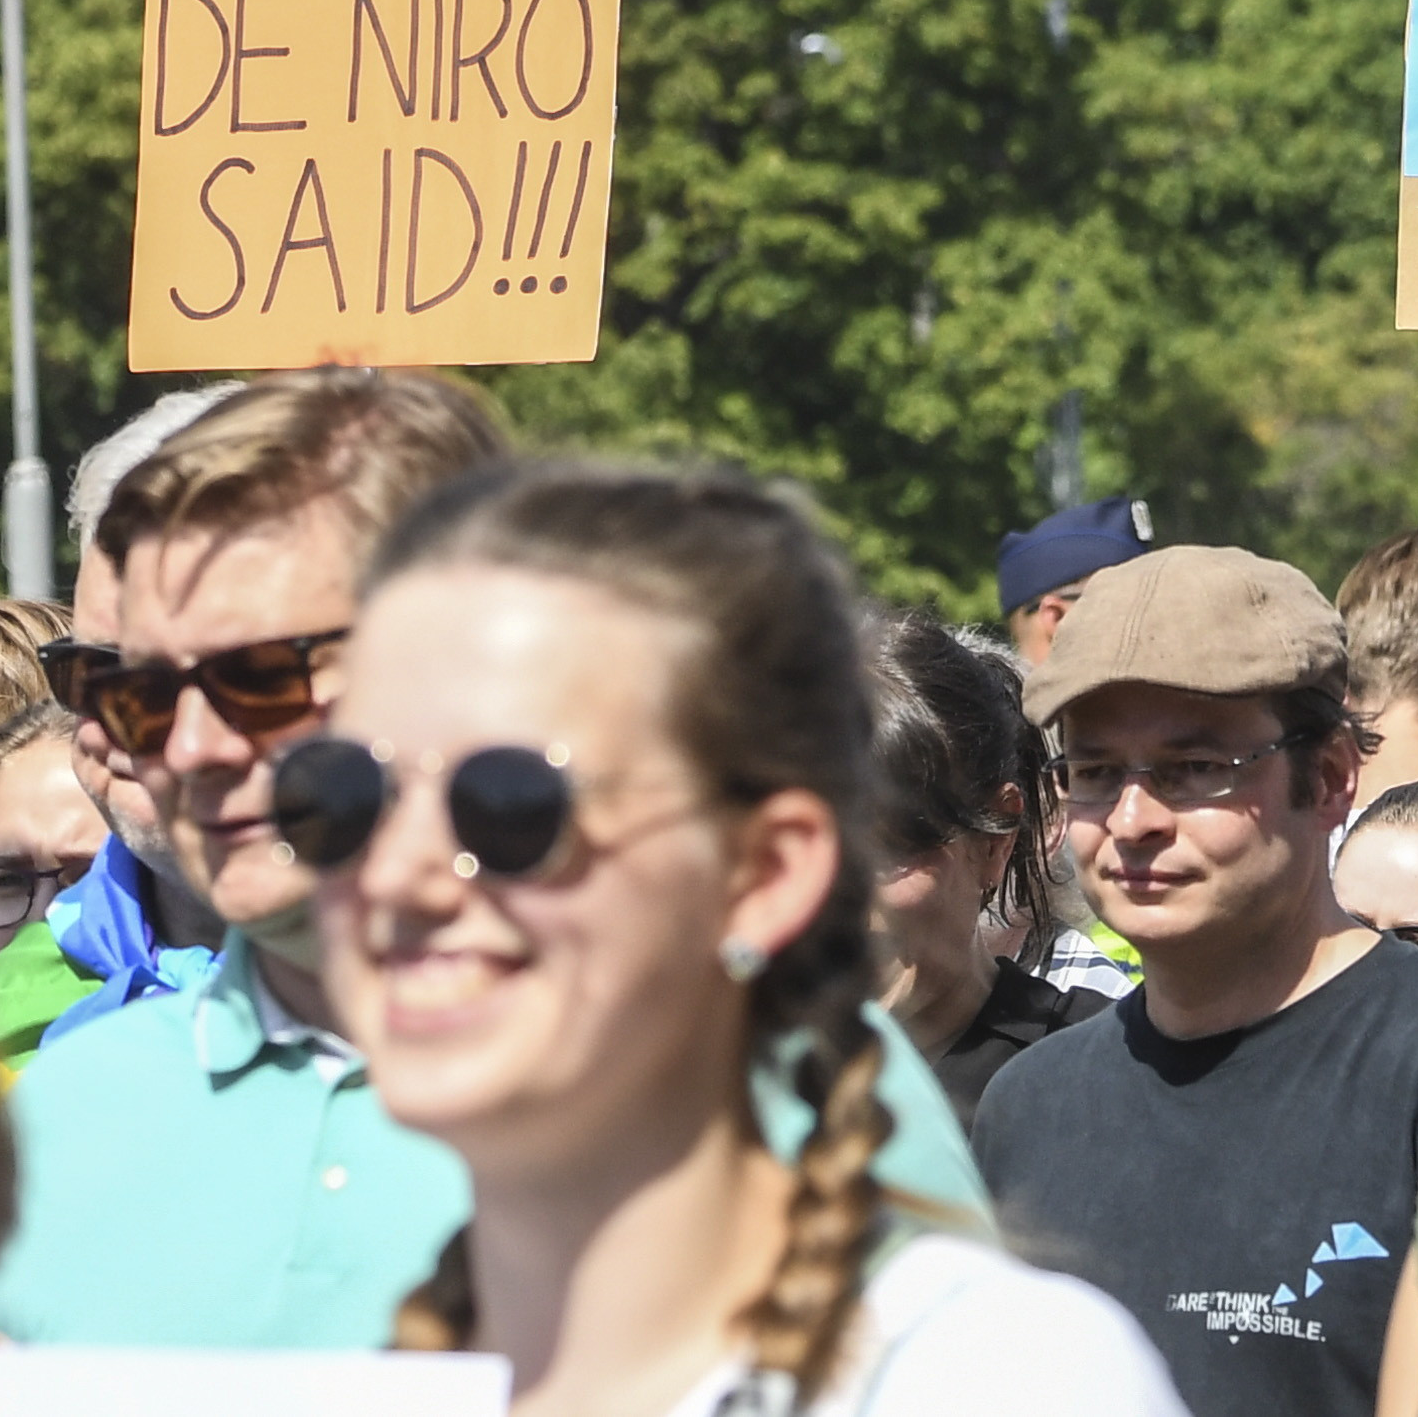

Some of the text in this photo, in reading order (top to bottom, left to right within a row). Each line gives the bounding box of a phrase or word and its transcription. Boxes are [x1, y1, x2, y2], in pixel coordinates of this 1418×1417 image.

[170, 140, 592, 320] SAID!!!
[1215, 1291, 1272, 1313] THINK
[1206, 1311, 1326, 1342] IMPOSSIBLE.
